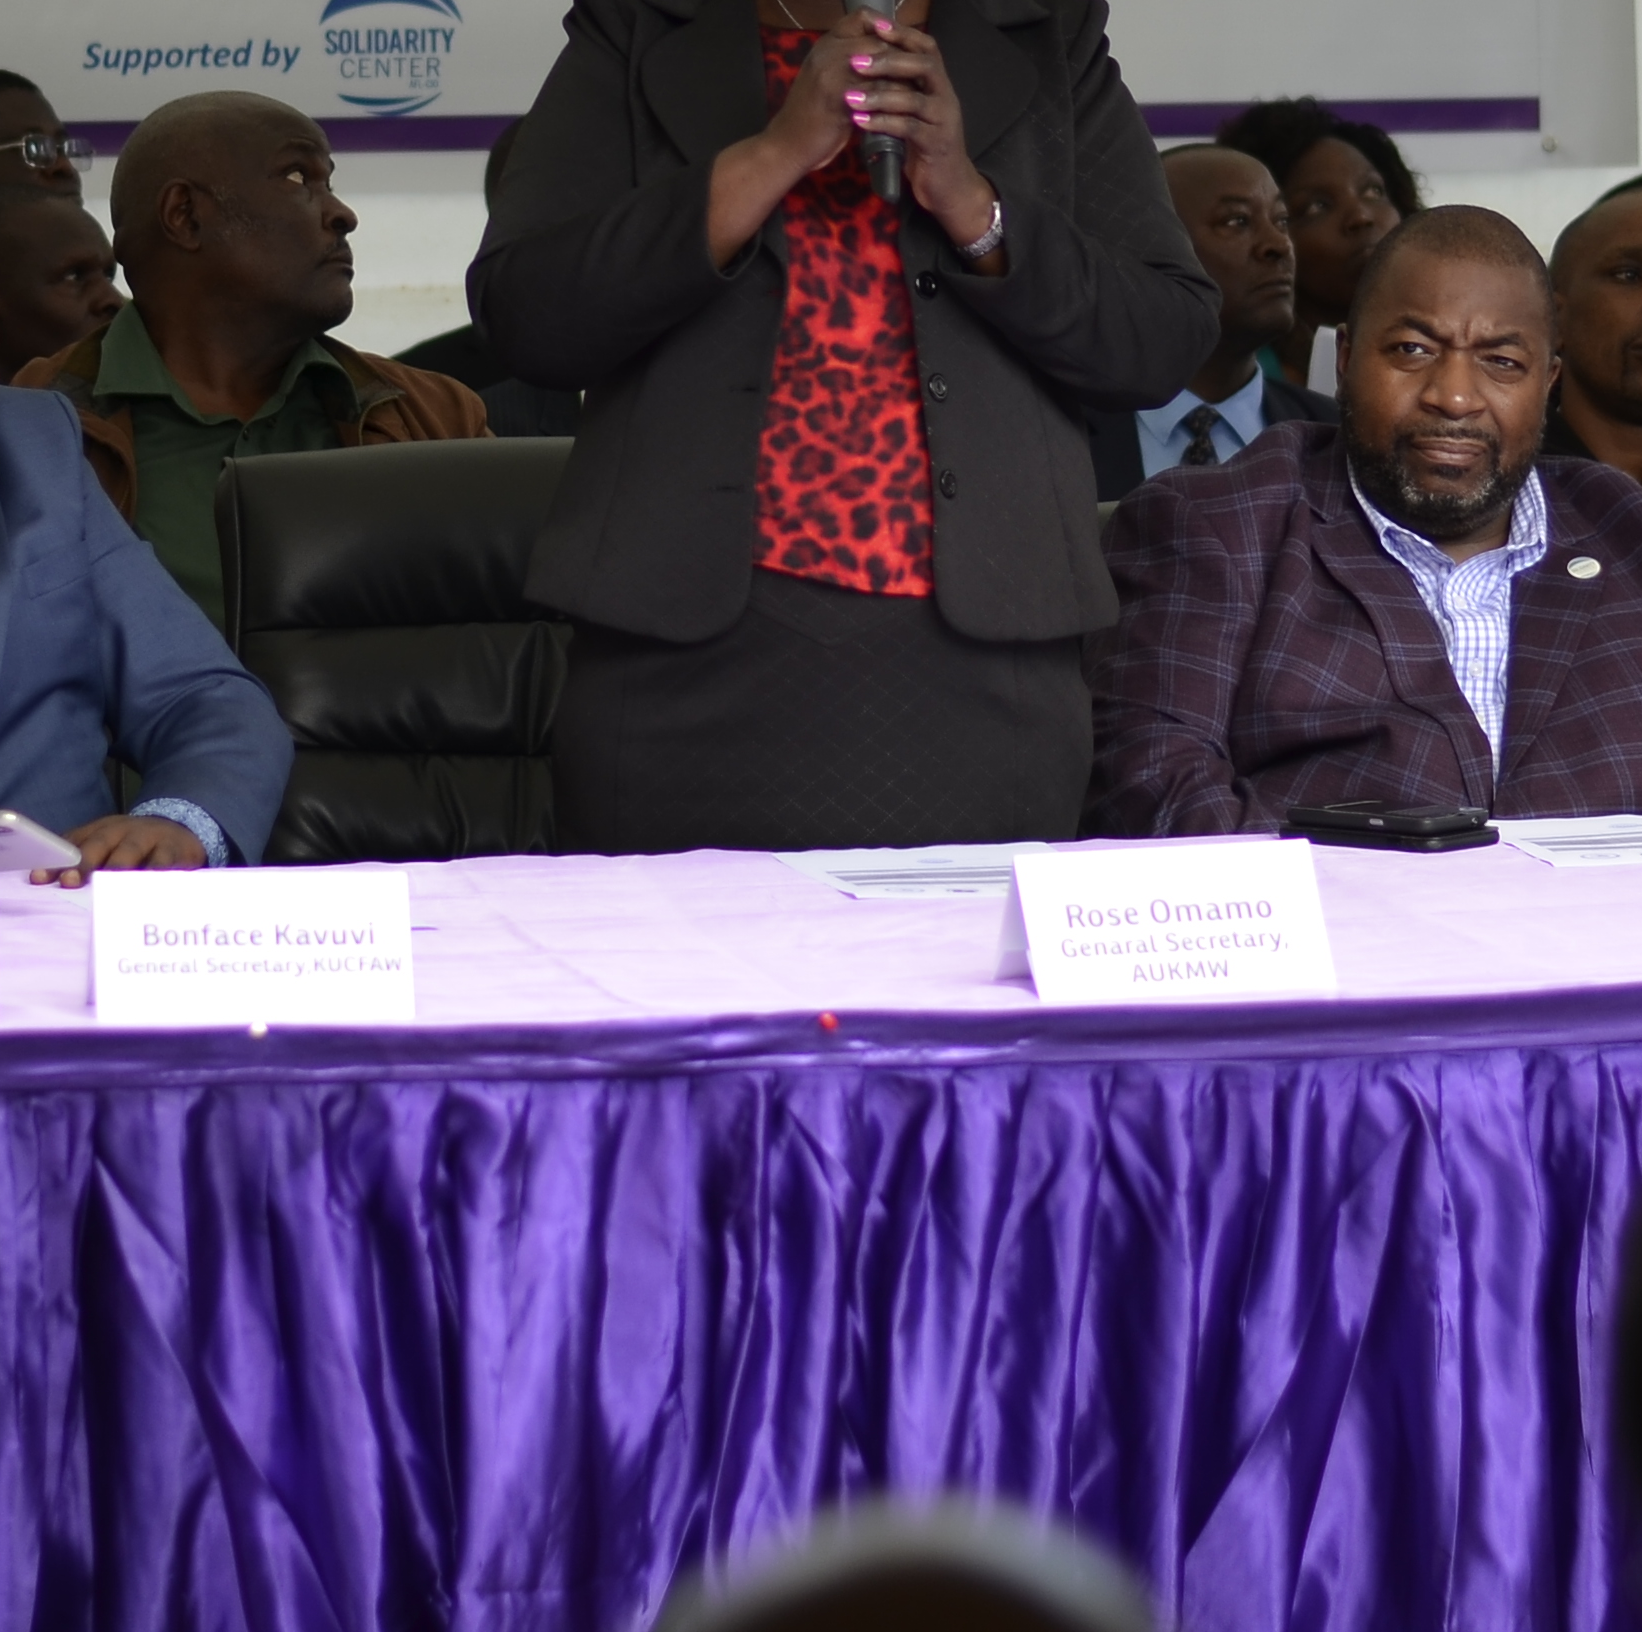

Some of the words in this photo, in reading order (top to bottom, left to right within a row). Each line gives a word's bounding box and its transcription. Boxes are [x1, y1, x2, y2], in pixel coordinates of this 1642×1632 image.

[325, 28, 455, 55] SOLIDARITY
[83, 39, 253, 75] Supported
[261, 39, 300, 74] by
[340, 57, 441, 79] CENTER
[1065, 904, 1139, 929] Rose
[1150, 898, 1272, 924] Omamo
[143, 924, 263, 947] Bonface
[275, 922, 375, 946] Kavuvi
[1166, 931, 1289, 952] Secretary,
[118, 957, 197, 975] General
[1132, 960, 1229, 982] AUKMW
